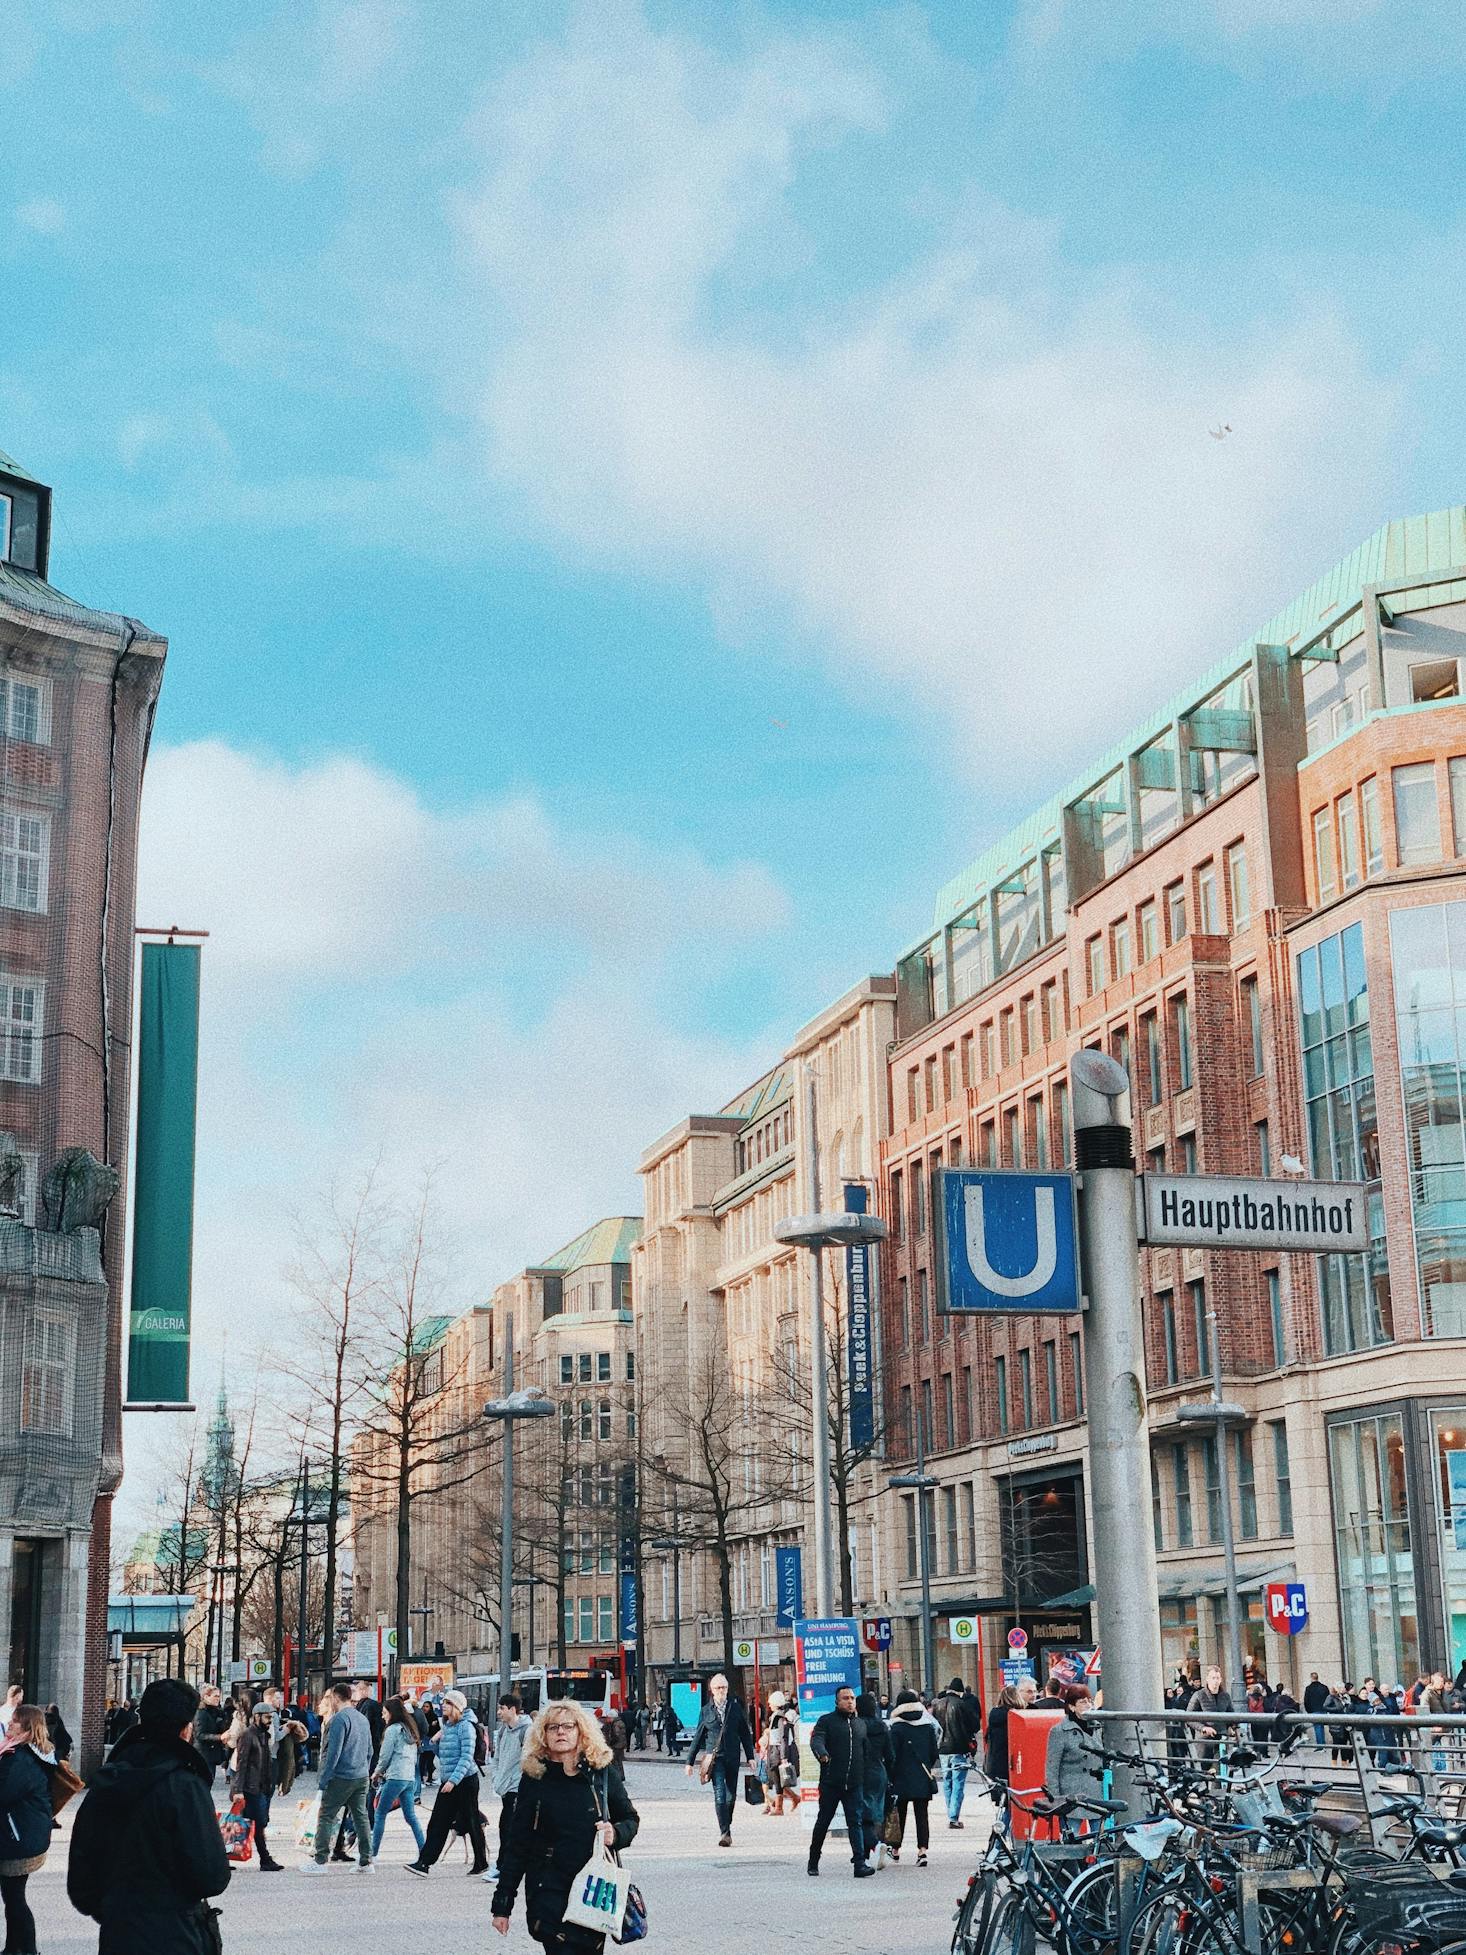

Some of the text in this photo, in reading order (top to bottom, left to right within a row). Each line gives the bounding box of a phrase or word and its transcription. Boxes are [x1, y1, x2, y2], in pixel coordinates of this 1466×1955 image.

[1161, 1190, 1353, 1235] Hauptbahnhof
[964, 1184, 1057, 1298] U
[145, 1317, 185, 1330] GALERIA
[852, 1244, 868, 1393] Peek&Cloppenbur
[782, 1556, 797, 1620] ANSON'S
[1271, 1593, 1305, 1618] P&C
[825, 1636, 835, 1646] LA
[836, 1635, 855, 1646] VISTA
[867, 1622, 890, 1640] P&C
[805, 1649, 822, 1660] UND
[805, 1661, 827, 1672] FREIE
